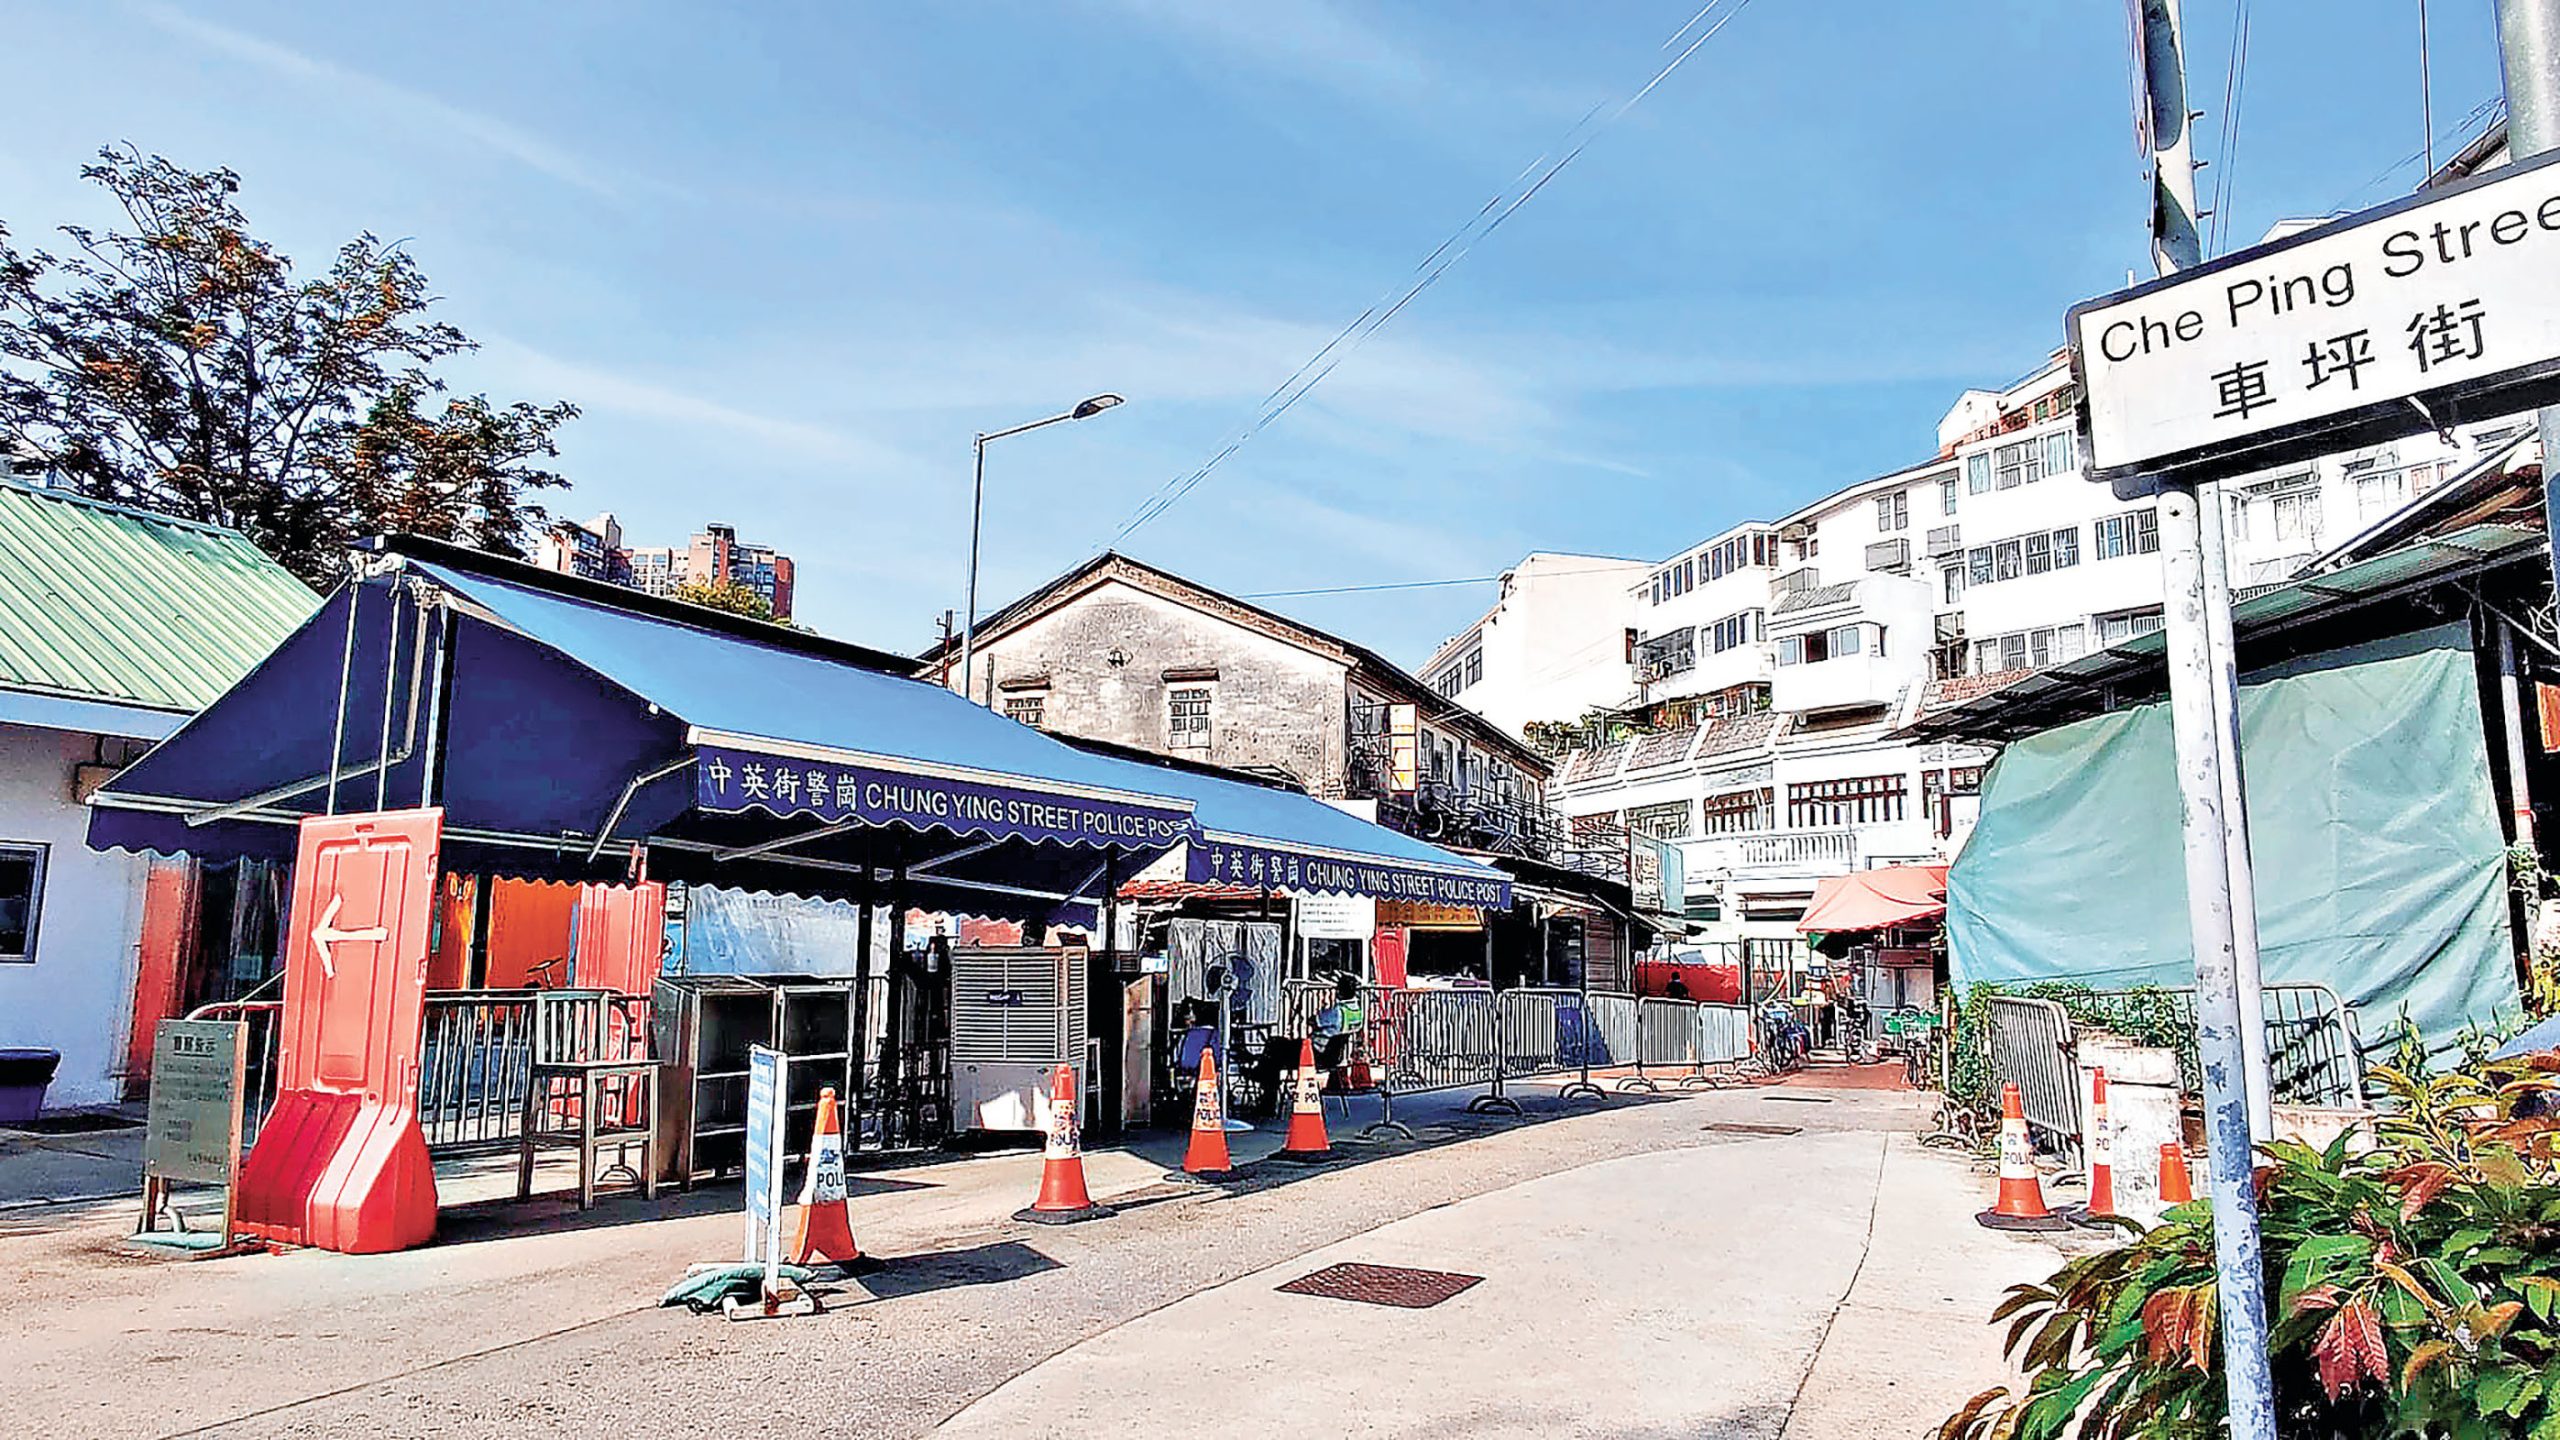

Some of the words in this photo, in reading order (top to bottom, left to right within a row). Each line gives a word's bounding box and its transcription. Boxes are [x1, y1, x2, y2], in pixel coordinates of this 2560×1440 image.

[2100, 310, 2204, 362] Che
[2226, 263, 2355, 328] Ping
[2382, 196, 2560, 278] Stree
[2210, 298, 2486, 420] 車坪街
[707, 756, 859, 812] 中英街警崗
[865, 783, 949, 817] CHUNG
[952, 793, 1004, 822] YING
[1007, 800, 1080, 831] STREET
[1083, 810, 1146, 838] POLICE
[1307, 861, 1355, 890] CHUNG
[1358, 868, 1390, 893] YING
[1391, 873, 1436, 897] STREET
[1437, 878, 1475, 901] POLICE
[1476, 884, 1501, 903] POST
